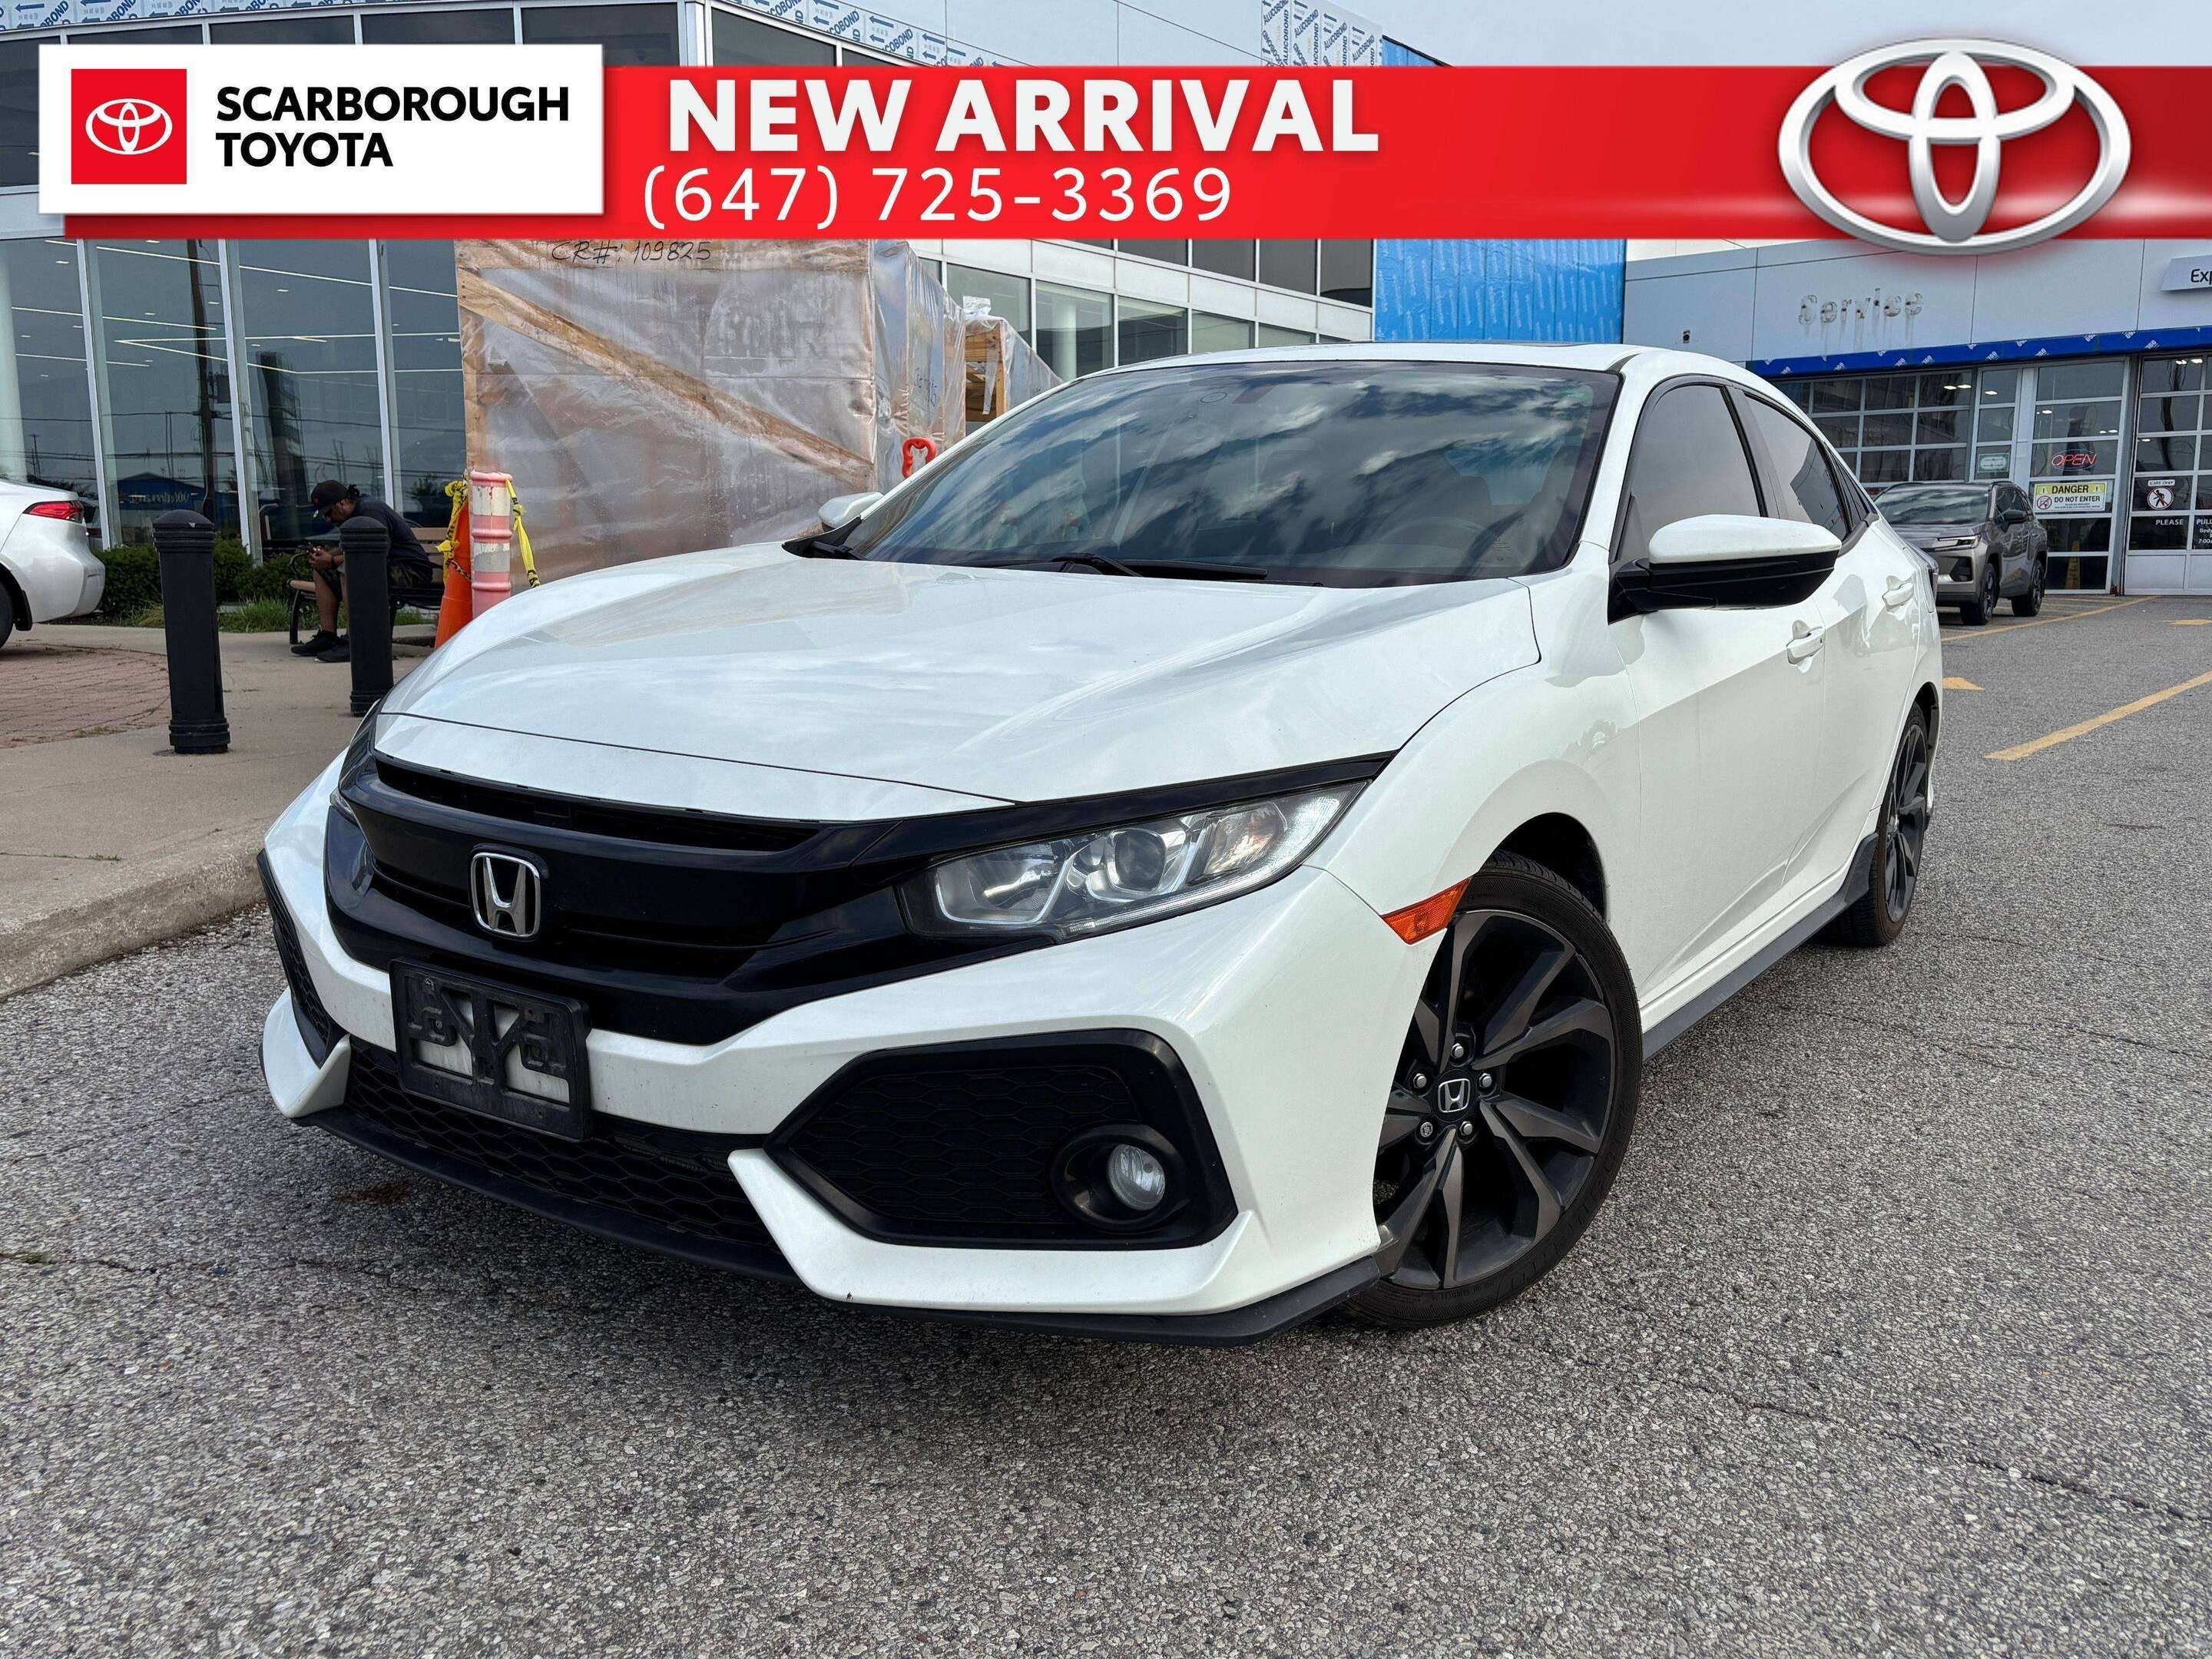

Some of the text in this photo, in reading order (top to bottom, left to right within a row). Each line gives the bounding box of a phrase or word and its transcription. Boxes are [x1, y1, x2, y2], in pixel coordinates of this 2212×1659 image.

[632, 240, 712, 264] 109825
[2190, 268, 2212, 286] Ex
[2051, 453, 2098, 468] OPEN
[2051, 485, 2089, 494] DANGER
